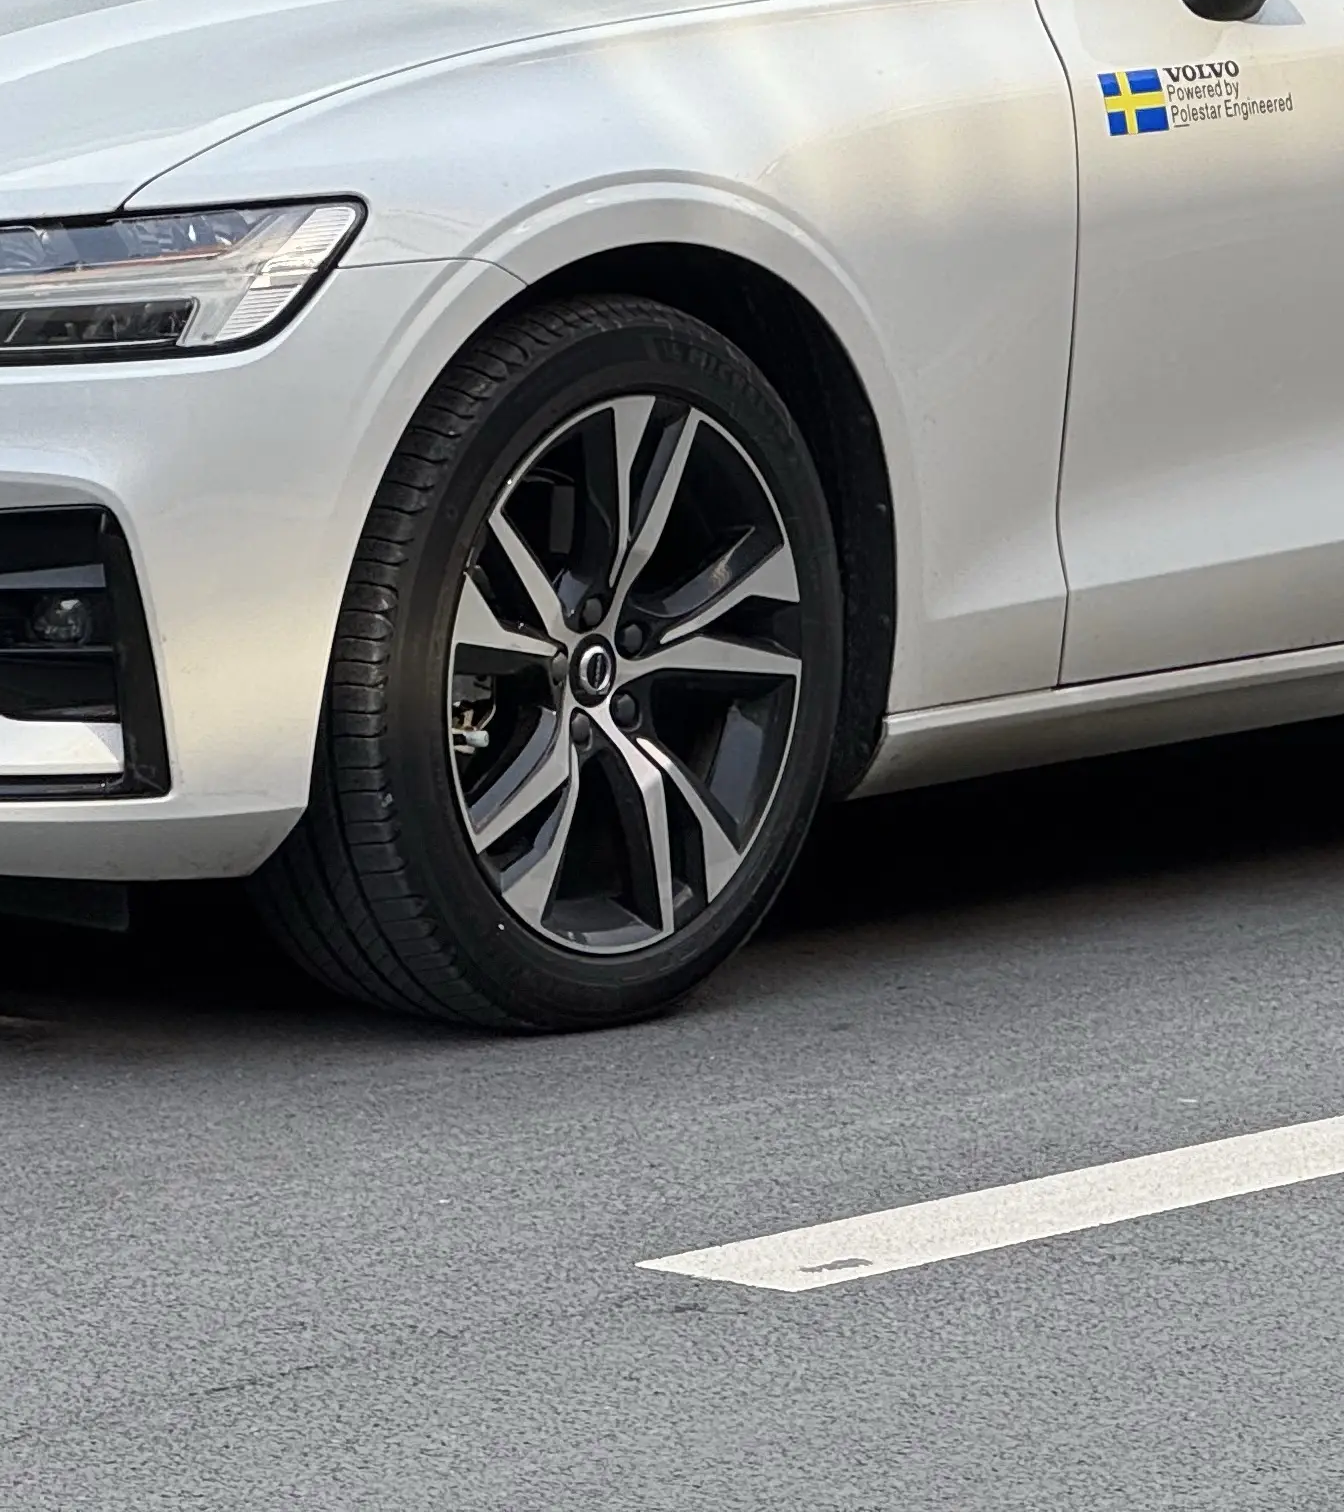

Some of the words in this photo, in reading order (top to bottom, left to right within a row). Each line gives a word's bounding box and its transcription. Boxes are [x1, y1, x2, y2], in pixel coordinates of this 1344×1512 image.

[1163, 60, 1240, 82] VOLVO
[1166, 83, 1223, 102] Powered
[1225, 79, 1240, 99] by
[1170, 102, 1222, 123] Polestar
[1225, 92, 1294, 121] Engineered
